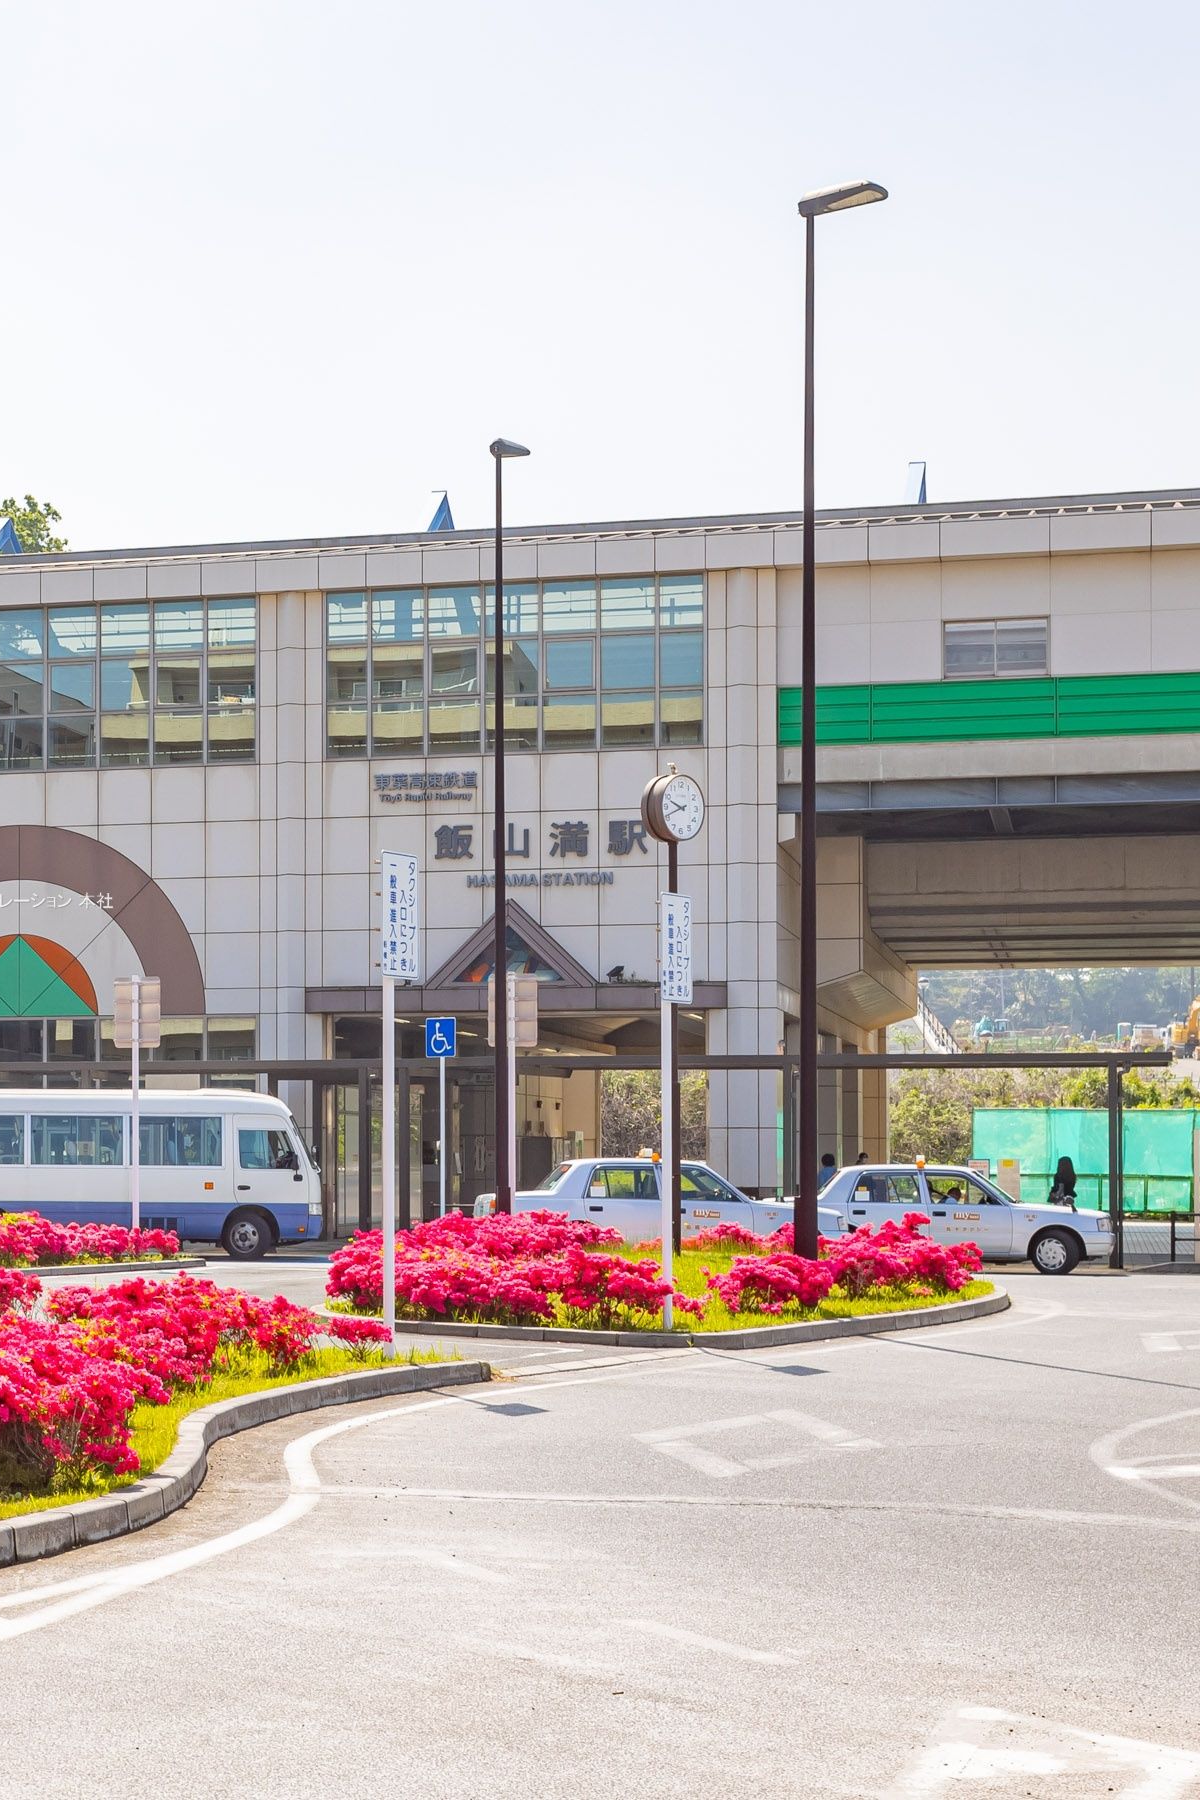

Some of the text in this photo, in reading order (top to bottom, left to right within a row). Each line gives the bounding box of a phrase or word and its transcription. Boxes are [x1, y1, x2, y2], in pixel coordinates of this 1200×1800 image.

[374, 771, 477, 791] 東葉高速鉄道
[405, 793, 433, 803] Rapid
[435, 792, 473, 802] Railway
[434, 820, 648, 860] 飯山満駅
[542, 871, 614, 887] STATION
[389, 863, 398, 971] 一般車進入禁止
[399, 889, 408, 972] 入口につき
[408, 862, 416, 972] タクシープール
